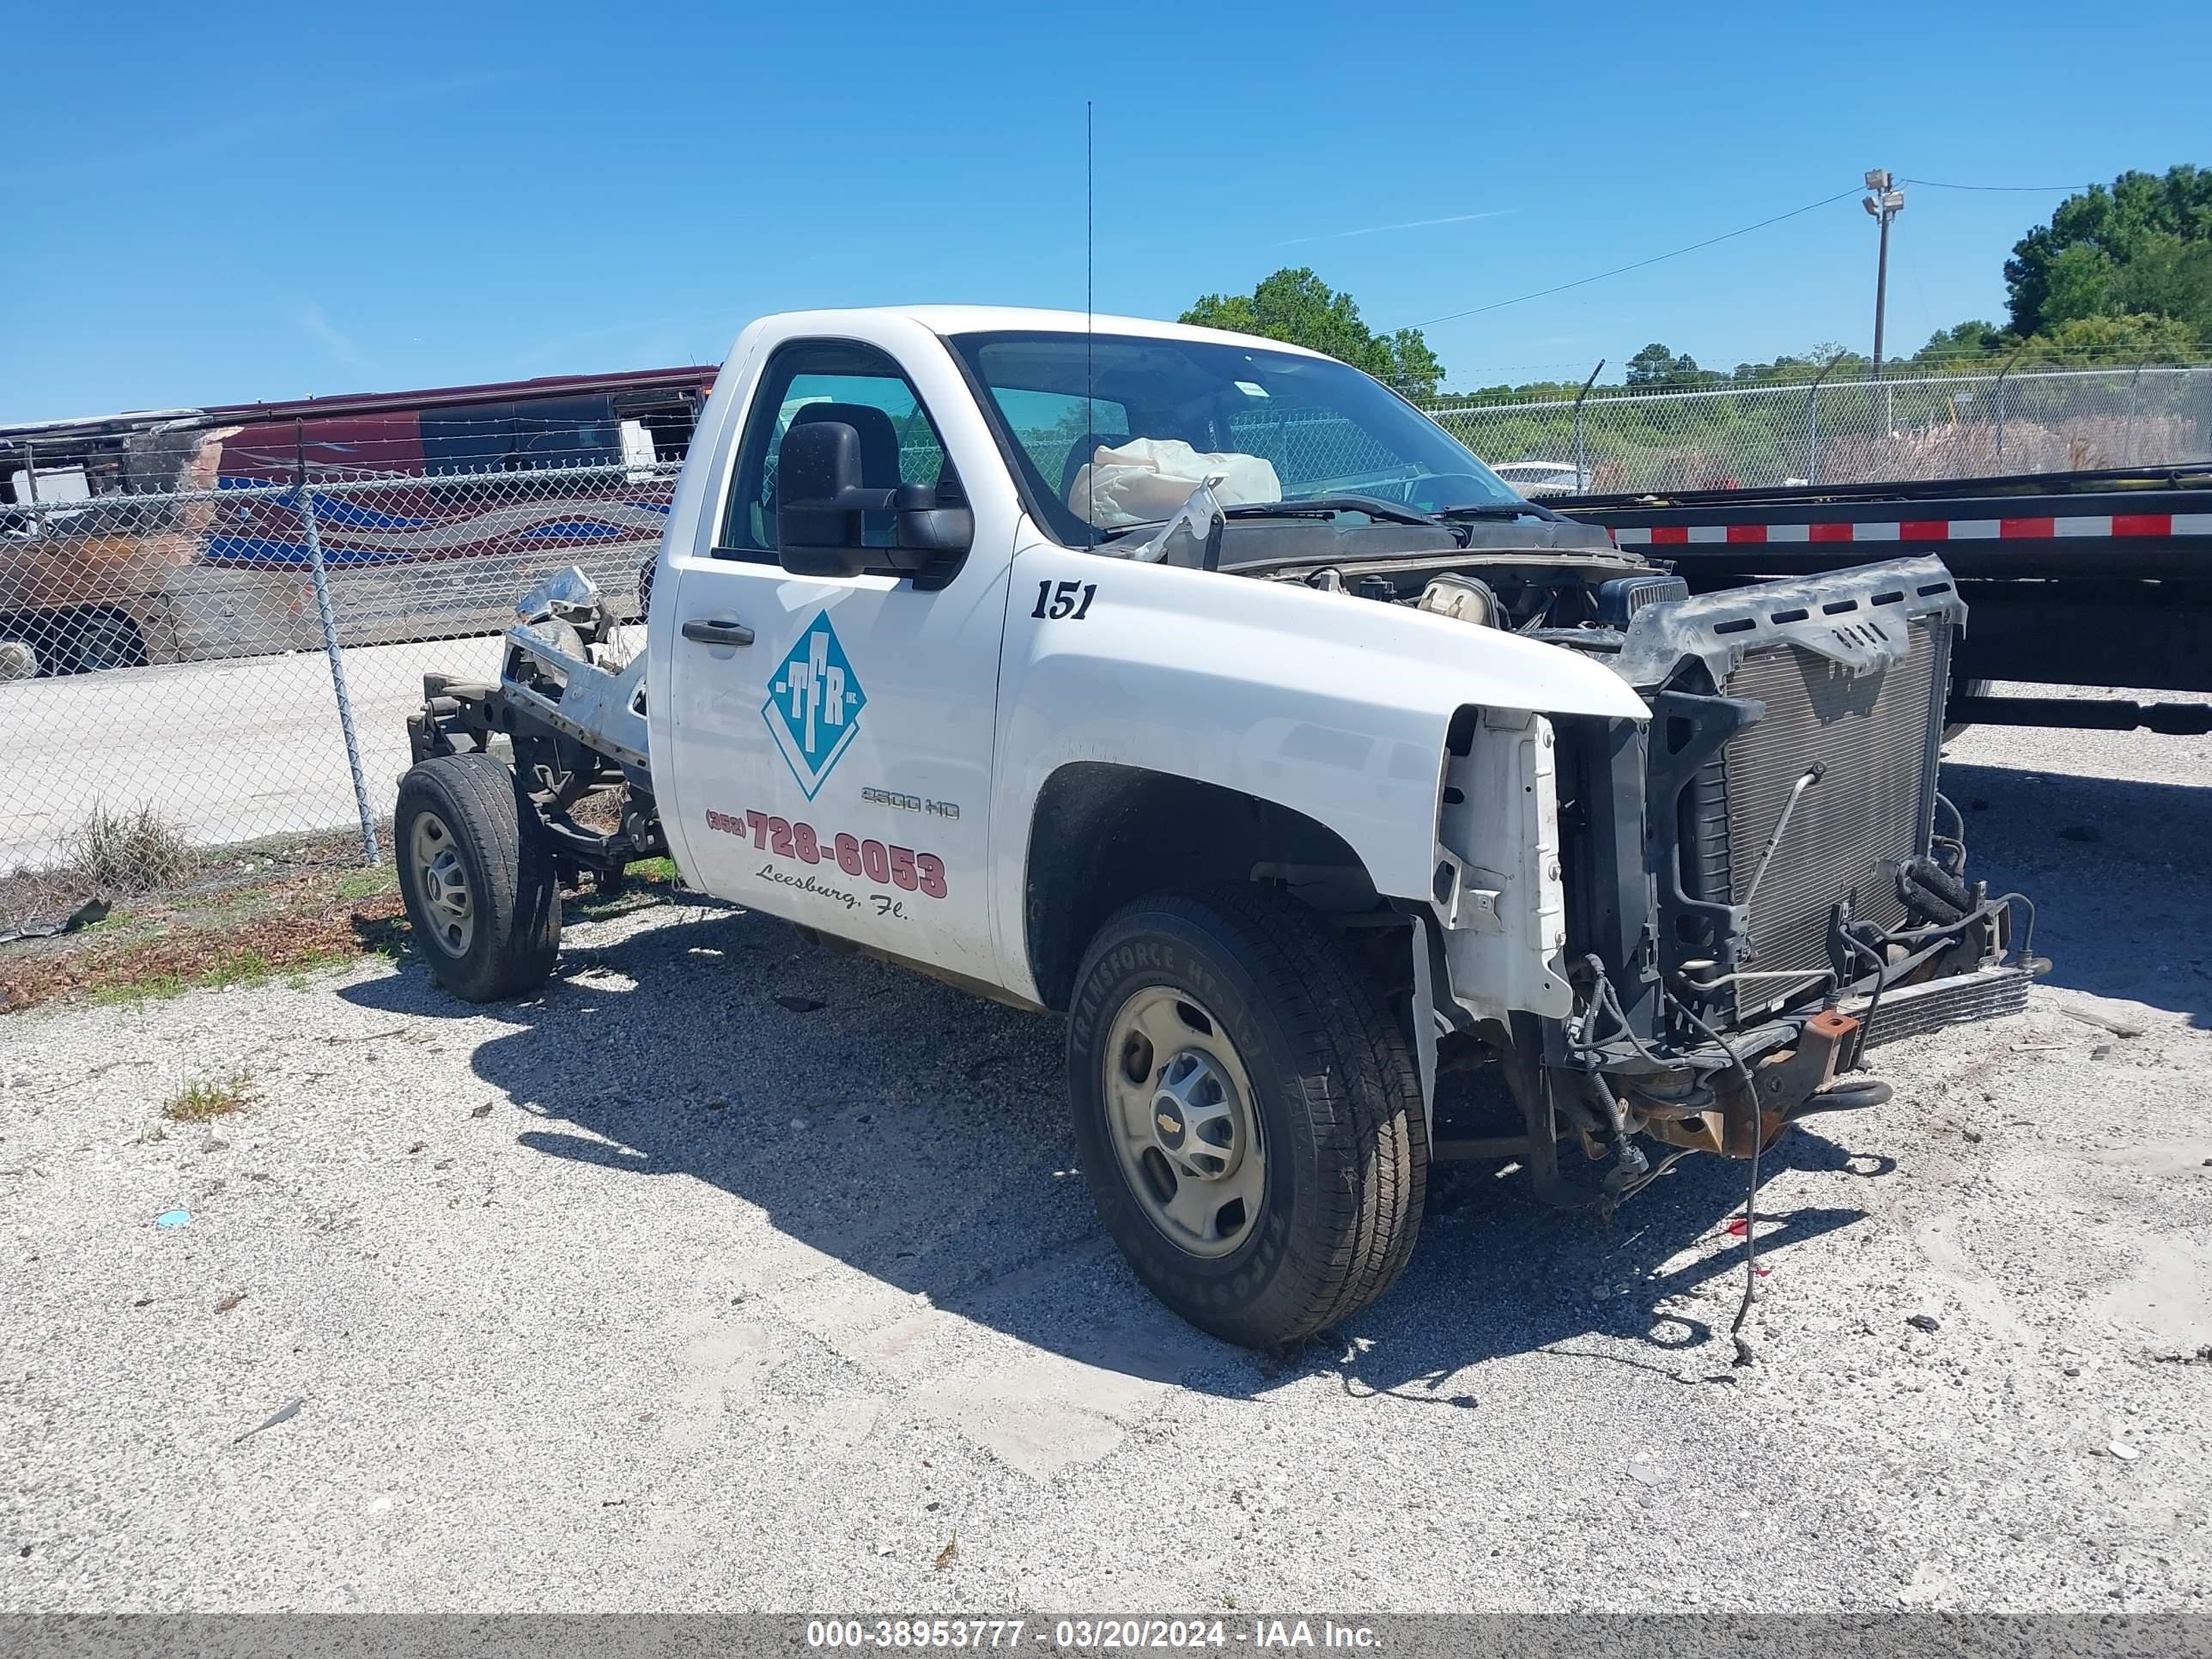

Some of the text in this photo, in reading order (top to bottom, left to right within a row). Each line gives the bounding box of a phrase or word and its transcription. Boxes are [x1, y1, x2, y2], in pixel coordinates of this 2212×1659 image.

[1031, 580, 1097, 622] 151
[861, 787, 961, 821] 2500 HD
[706, 809, 948, 899] (352) 728-6053
[756, 864, 909, 921] Leesburg, Fl.
[1072, 942, 1176, 1057] TRANSFORCE
